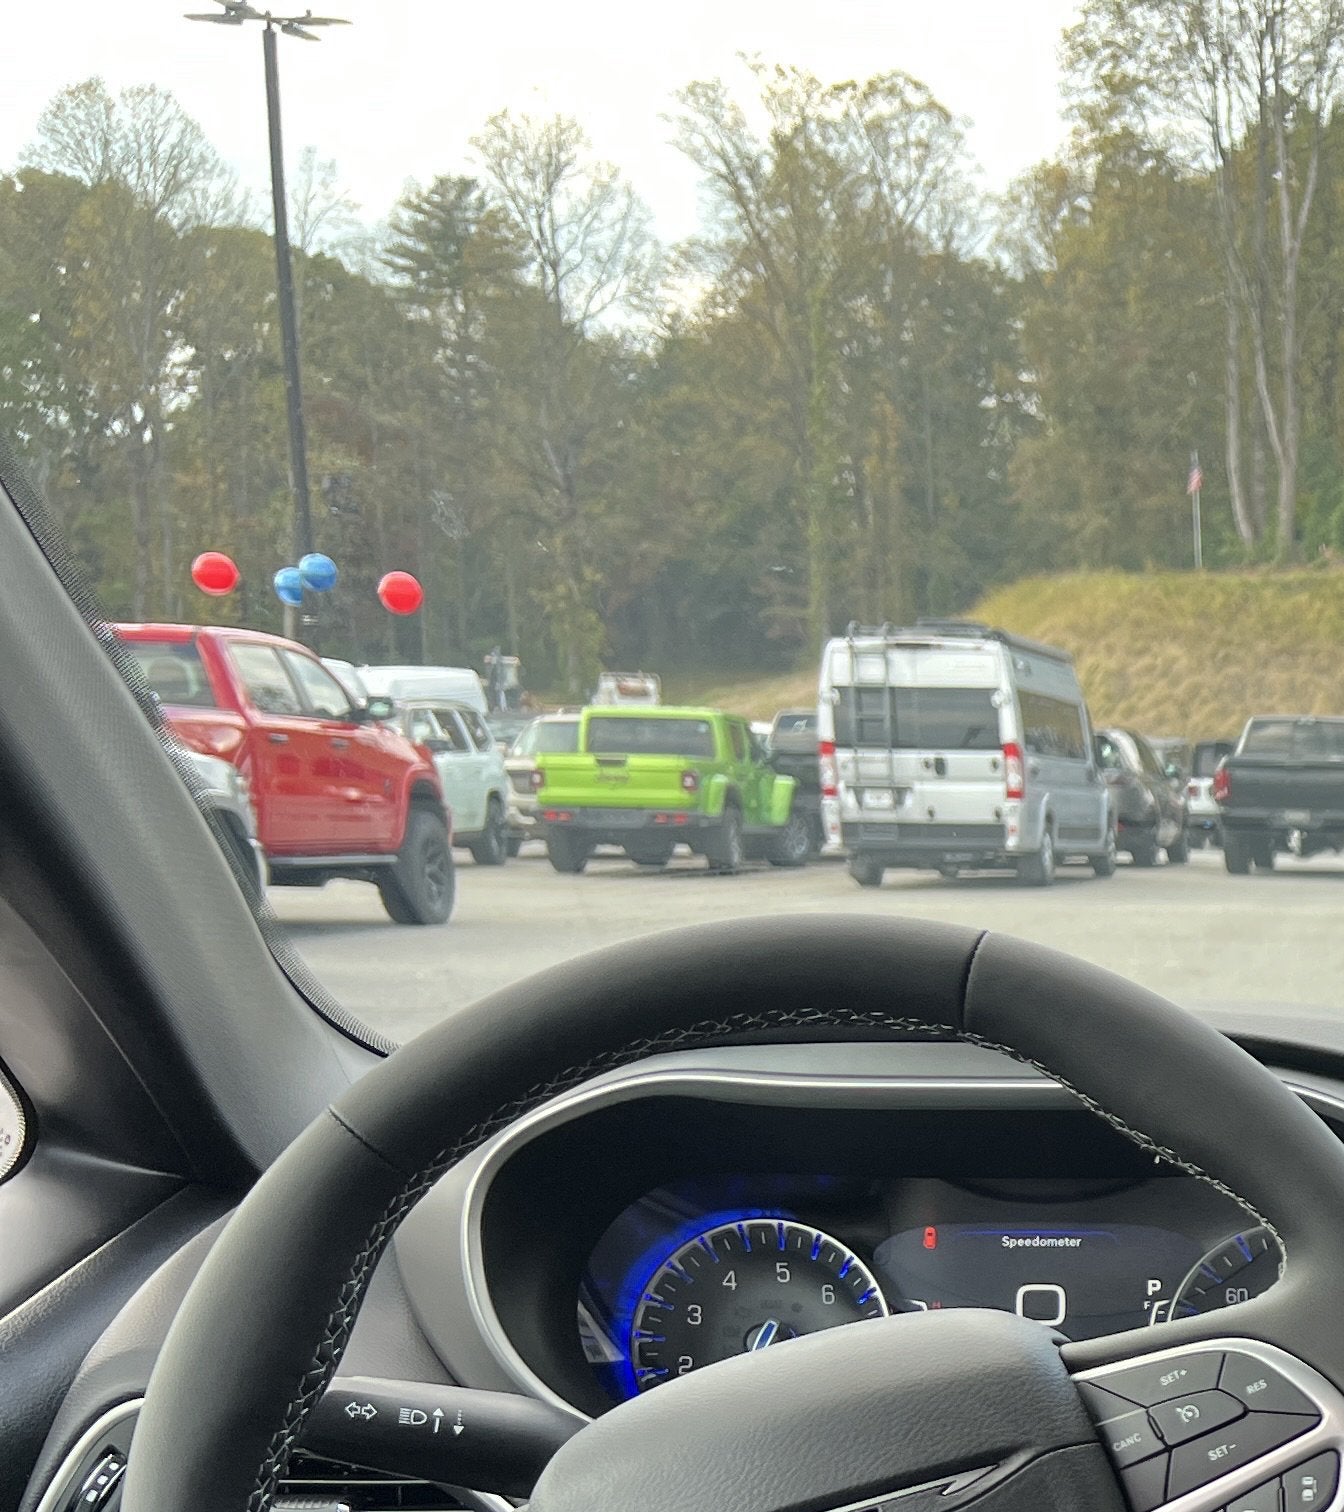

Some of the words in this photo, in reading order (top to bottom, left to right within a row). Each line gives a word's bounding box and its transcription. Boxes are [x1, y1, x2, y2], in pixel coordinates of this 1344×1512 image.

[1001, 1235, 1082, 1248] Speedometer
[722, 1270, 738, 1291] 4
[775, 1262, 790, 1283] 5
[821, 1284, 836, 1305] 6
[1147, 1280, 1162, 1296] P
[1225, 1287, 1249, 1304] 60
[687, 1304, 703, 1325] 3
[678, 1356, 694, 1376] 2
[1159, 1368, 1188, 1386] SET+
[1246, 1379, 1268, 1394] RES
[1113, 1432, 1142, 1452] CANC
